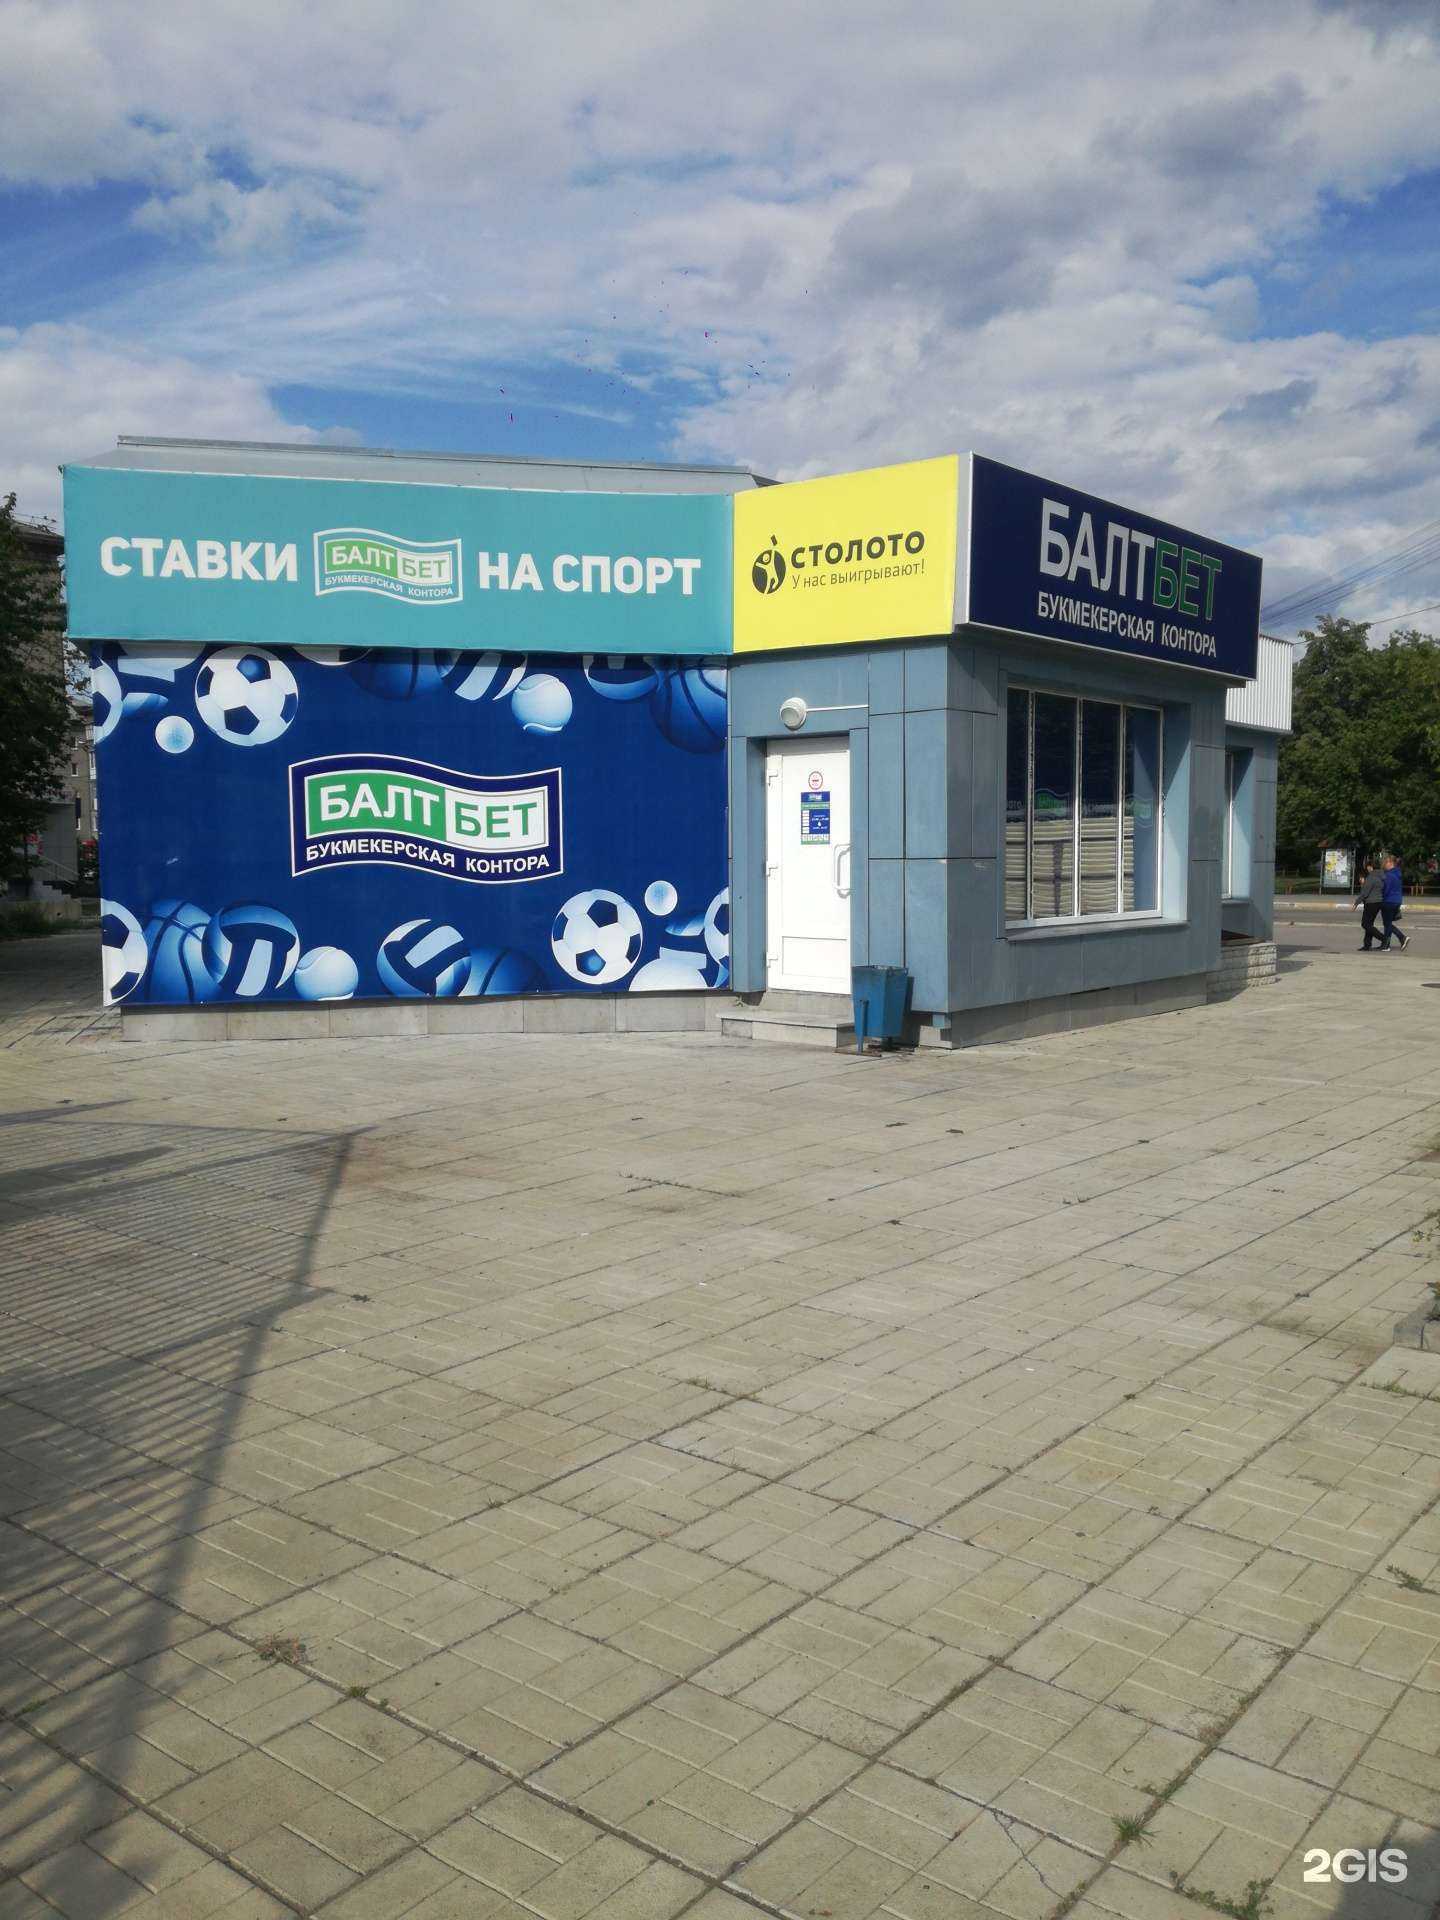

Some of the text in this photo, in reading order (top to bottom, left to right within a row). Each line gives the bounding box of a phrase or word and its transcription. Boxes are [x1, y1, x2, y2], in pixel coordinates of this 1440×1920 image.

[100, 536, 702, 595] СТАВКИ НА СПОРТ
[791, 531, 925, 569] СТОЛОТО
[325, 574, 453, 597] БУКМЕКЕРСКАЯ КОНТОРА
[803, 575, 827, 588] нас
[830, 558, 925, 585] выигрывают!
[1037, 591, 1217, 658] БУКМЕКЕРСКАЯ КОНТОРА
[306, 838, 550, 873] БУКМЕКЕРСКАЯ КОНТОРА
